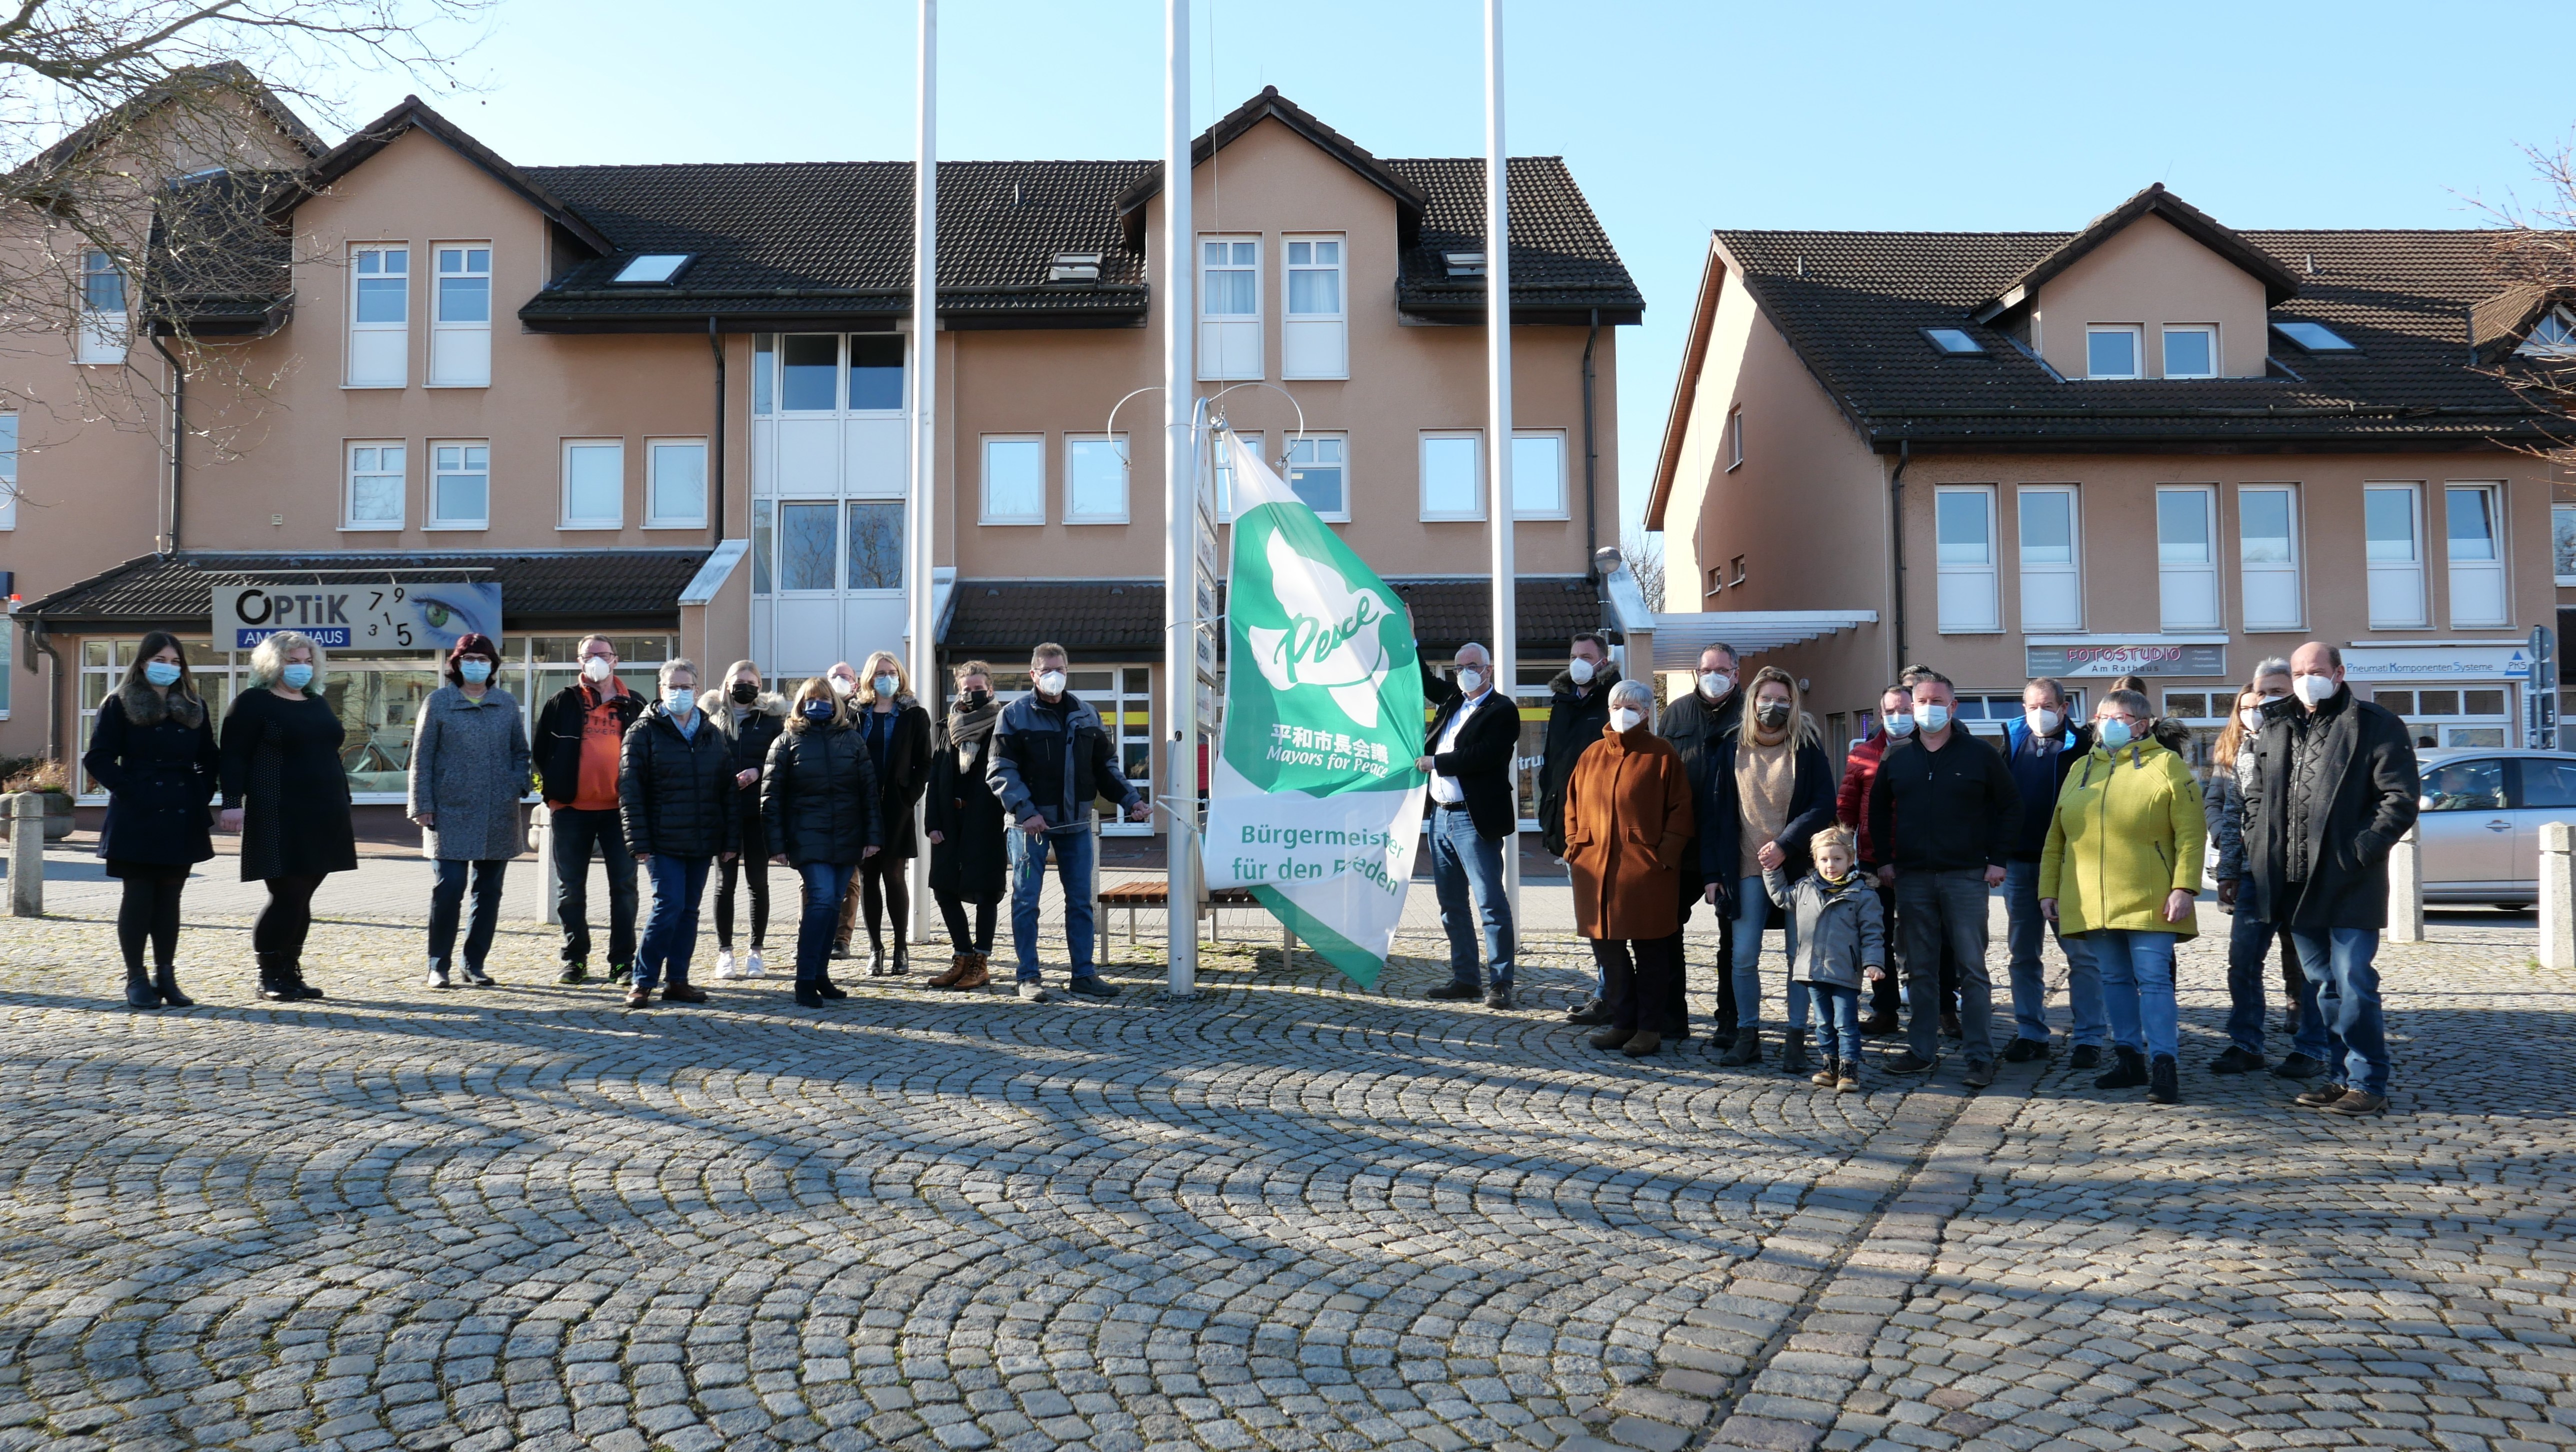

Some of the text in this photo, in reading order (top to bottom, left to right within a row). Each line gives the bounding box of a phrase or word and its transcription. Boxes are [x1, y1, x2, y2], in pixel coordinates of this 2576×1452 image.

[369, 588, 404, 610] 7 9
[382, 612, 391, 626] 1
[368, 622, 412, 646] 3 5
[2067, 647, 2182, 662] FOTOSTUDIO
[2508, 662, 2526, 670] PKS
[2346, 662, 2493, 673] Pneumati Komponenten Systeme
[1270, 723, 1389, 765] 平和市長会議
[1266, 745, 1389, 779] Mayors for Peace
[1242, 824, 1404, 859] Bürgermeister
[1232, 856, 1398, 896] für den Feden
